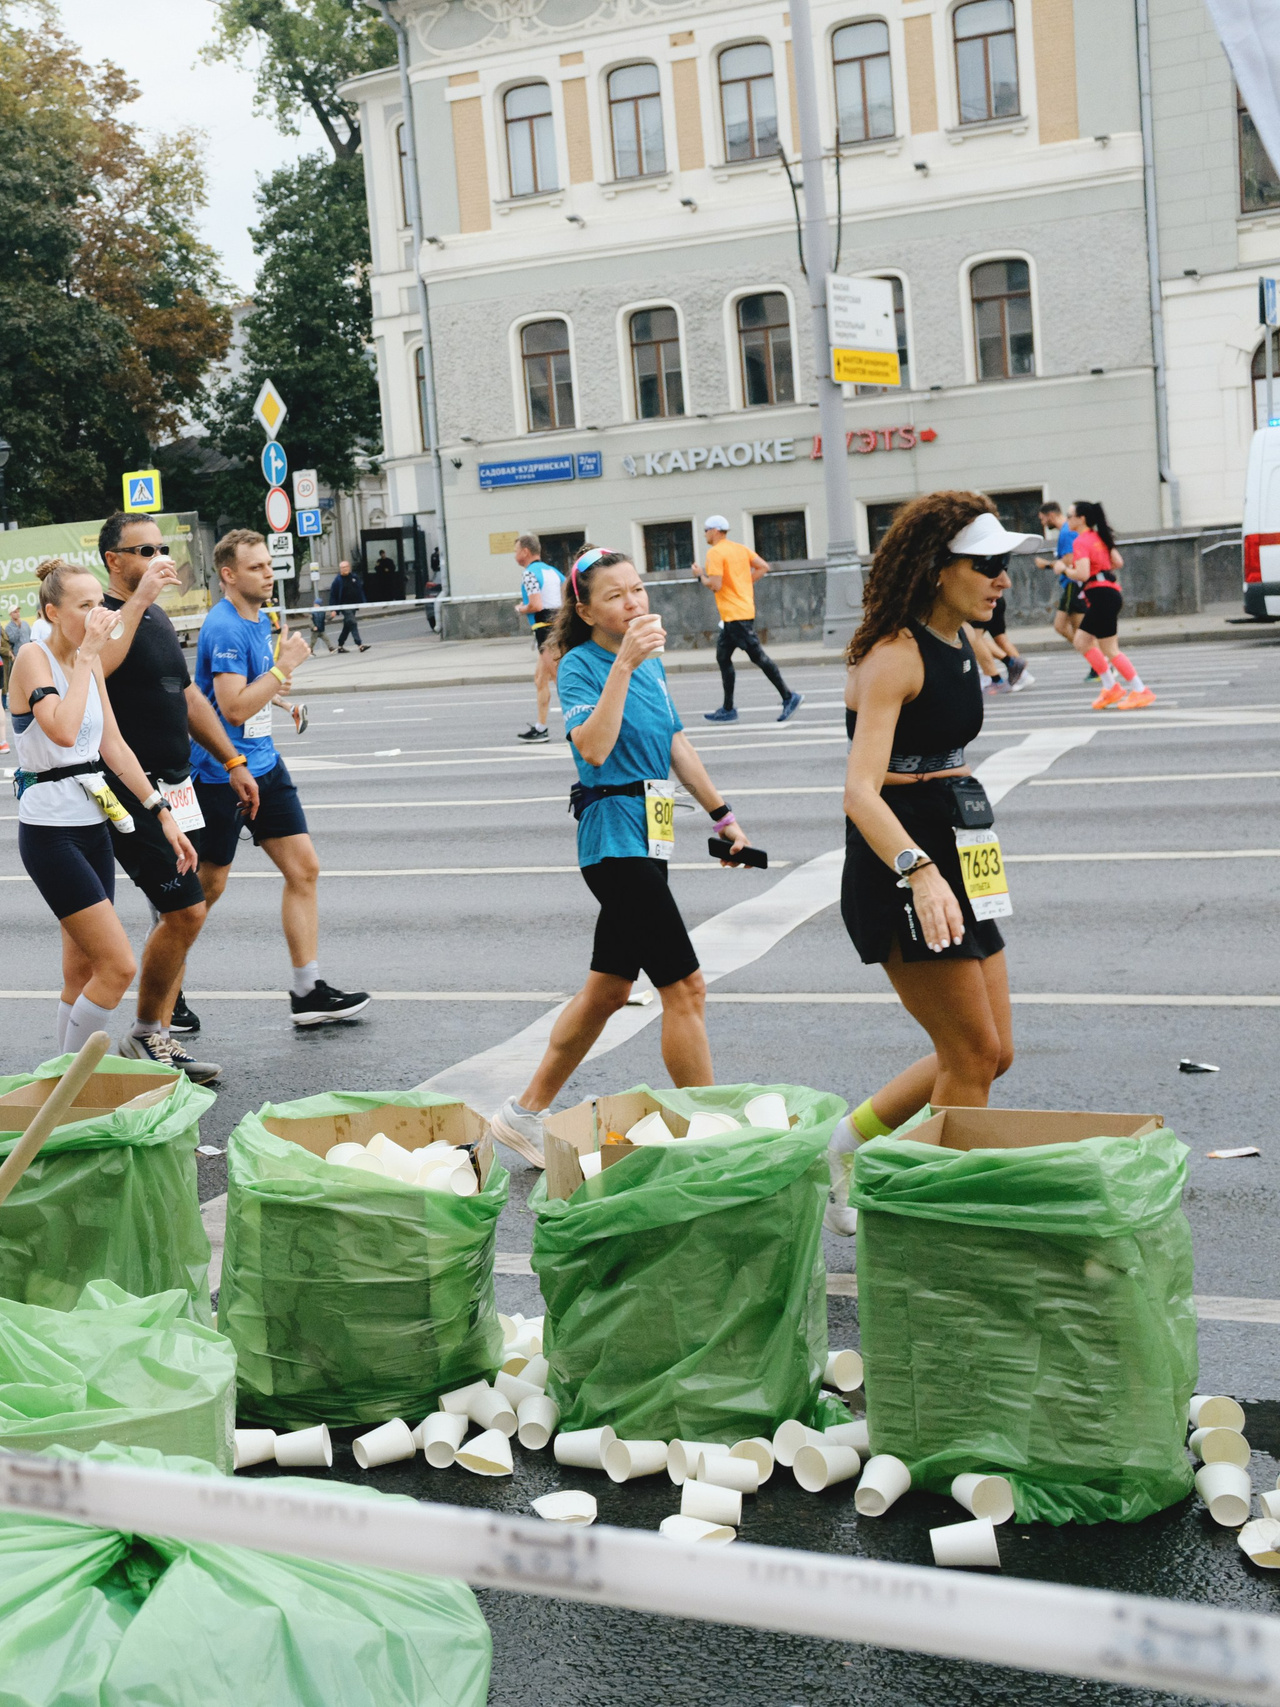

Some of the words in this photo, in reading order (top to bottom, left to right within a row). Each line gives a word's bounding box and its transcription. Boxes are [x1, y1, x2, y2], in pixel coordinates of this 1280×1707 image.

[644, 437, 796, 475] КАРАОКЕ
[810, 426, 917, 460] ЭTS
[480, 461, 570, 477] САДОВАЯ-КУДРИНСКАЯ
